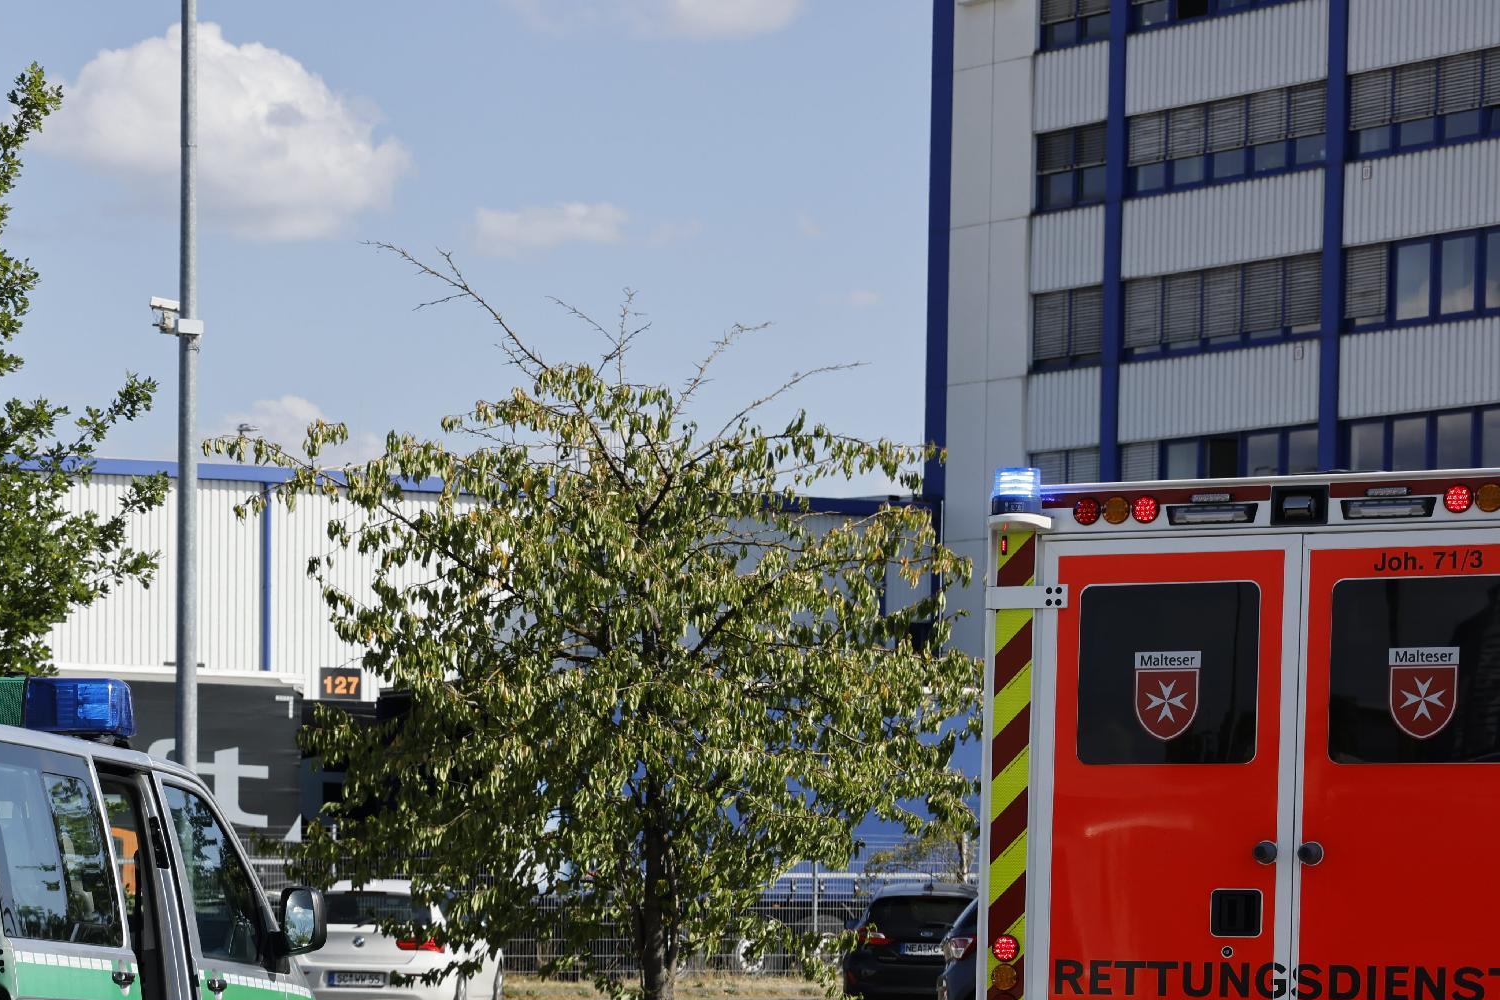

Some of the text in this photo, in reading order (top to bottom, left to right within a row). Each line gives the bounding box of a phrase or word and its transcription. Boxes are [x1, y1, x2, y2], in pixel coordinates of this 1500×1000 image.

[1373, 549, 1484, 572] Joh. 71/3
[1140, 653, 1196, 667] Malteser
[1394, 649, 1454, 663] Malteser
[323, 675, 360, 695] 127
